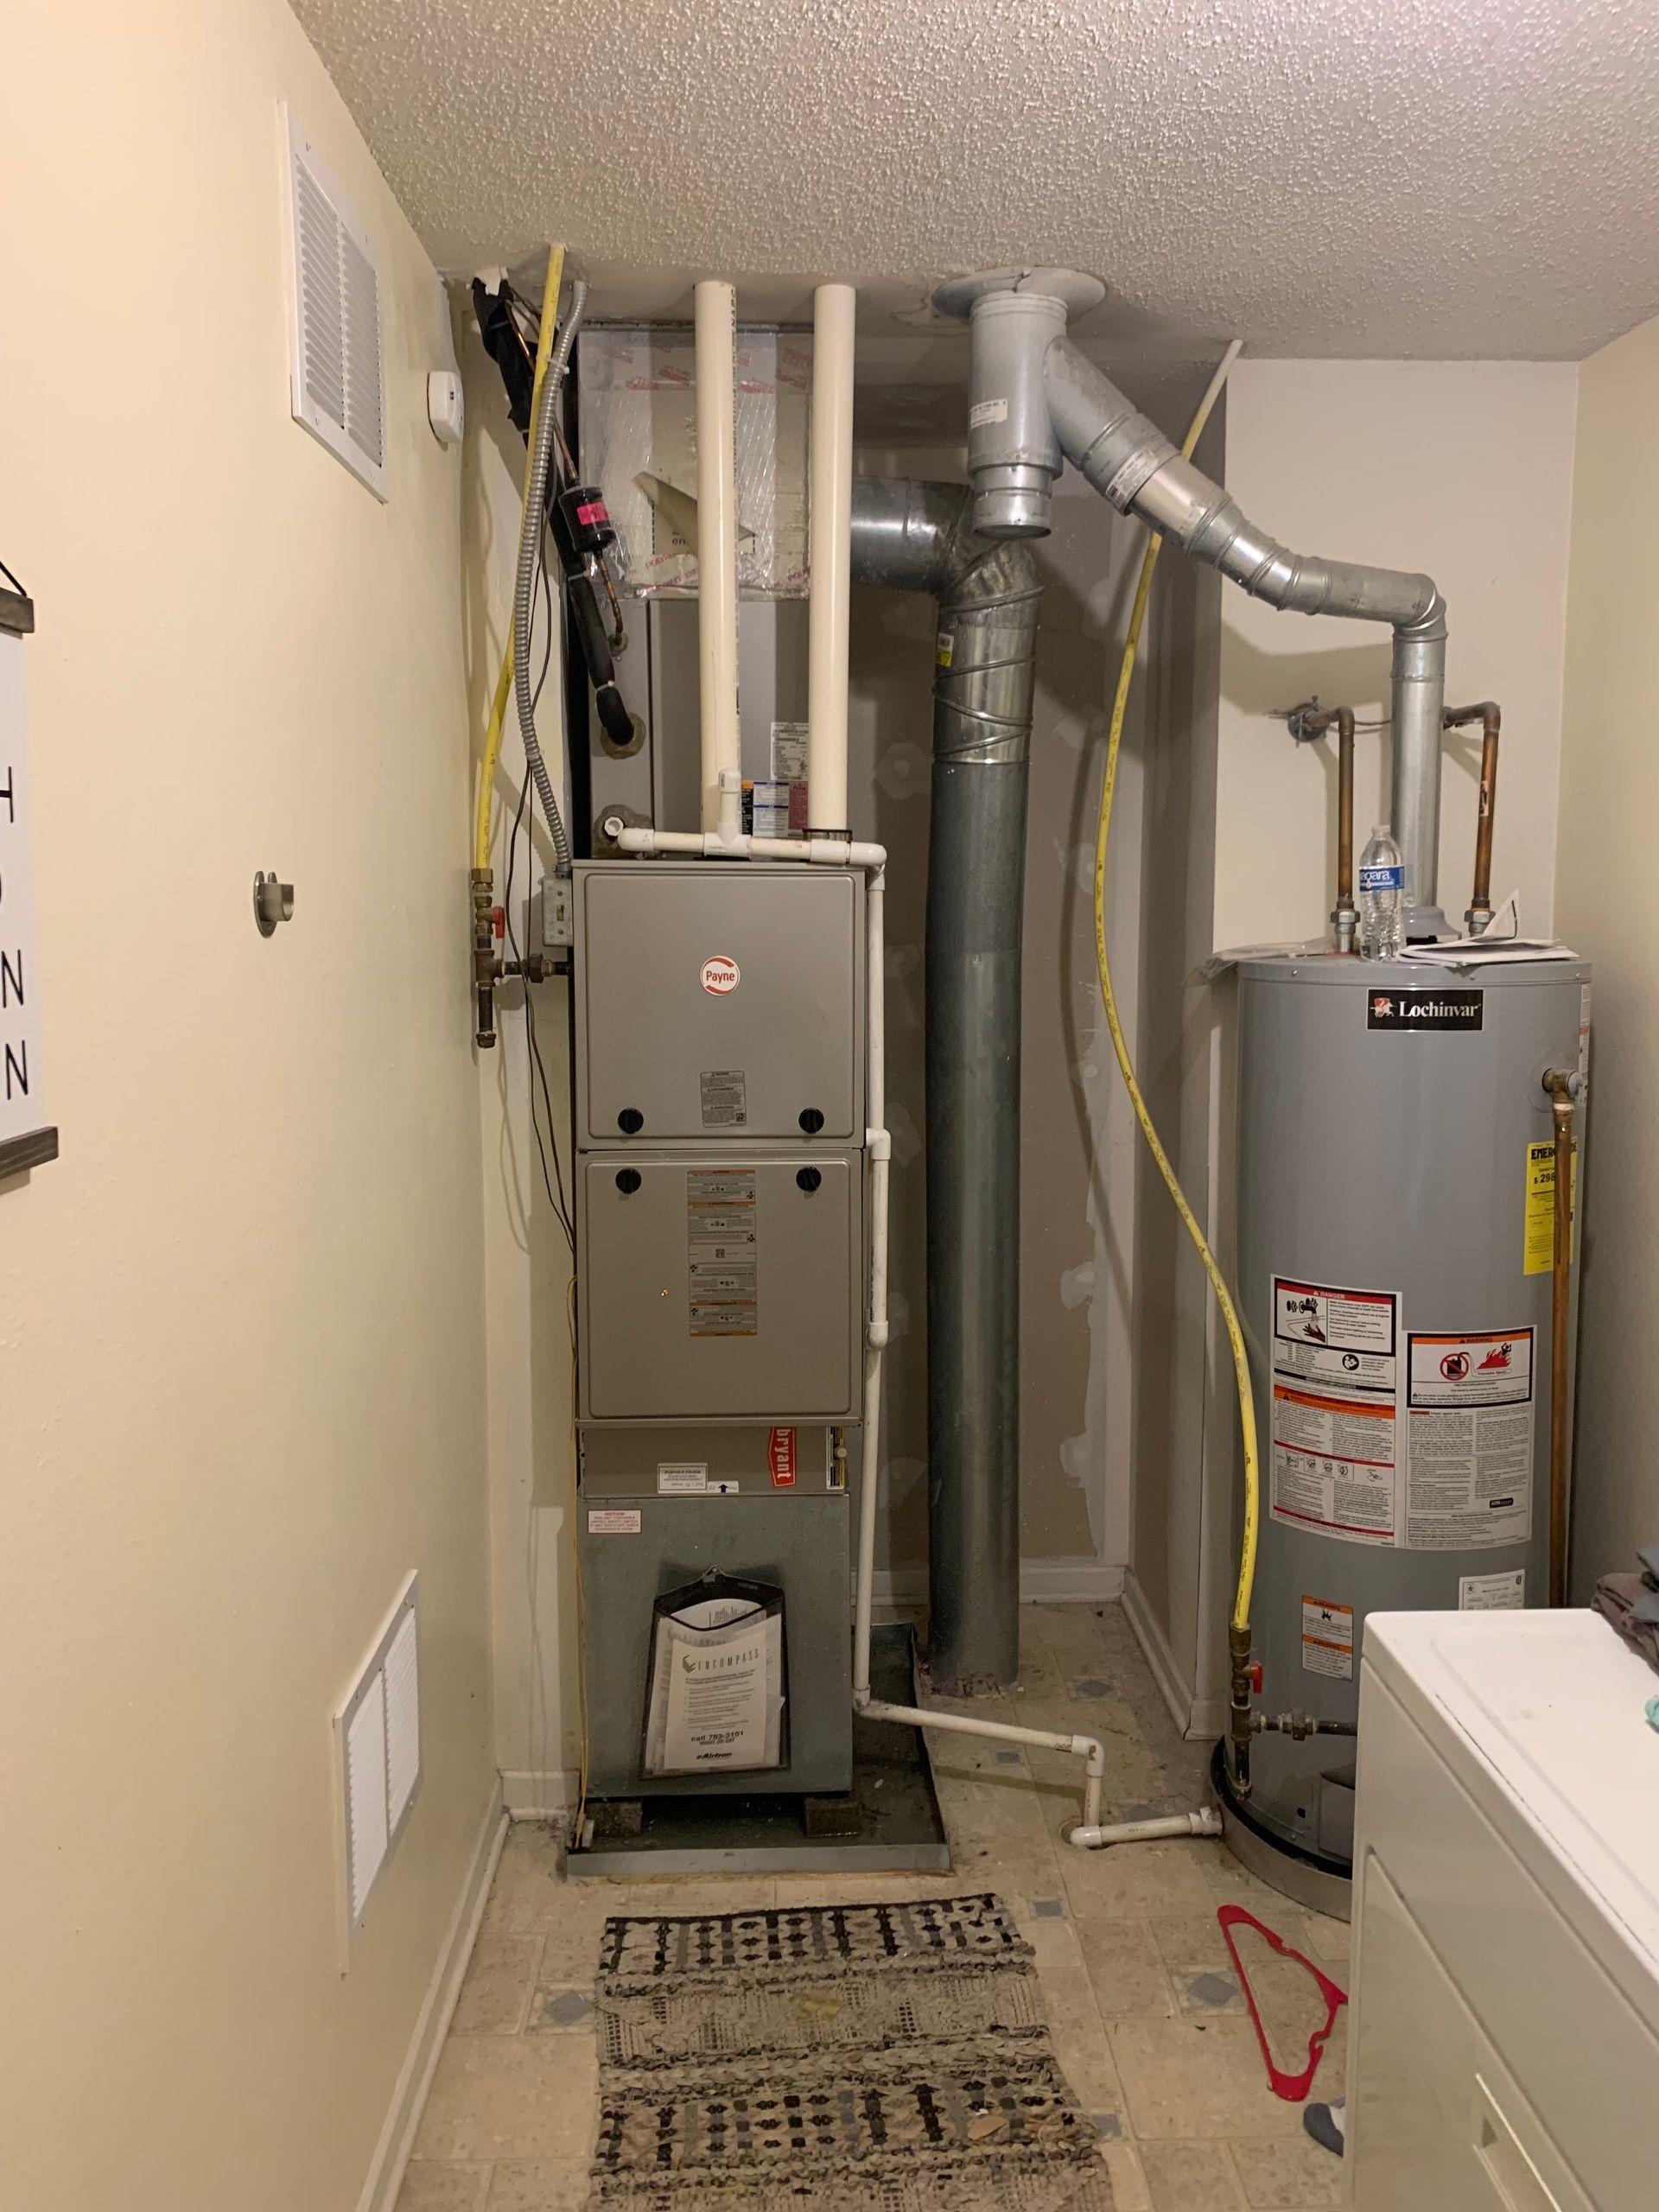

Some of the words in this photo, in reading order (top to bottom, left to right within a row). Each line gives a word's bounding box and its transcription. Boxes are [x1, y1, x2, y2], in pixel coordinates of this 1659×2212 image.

[706, 970, 735, 983] Payne
[1398, 1001, 1478, 1017] Lochinvar
[774, 1428, 791, 1478] bryant
